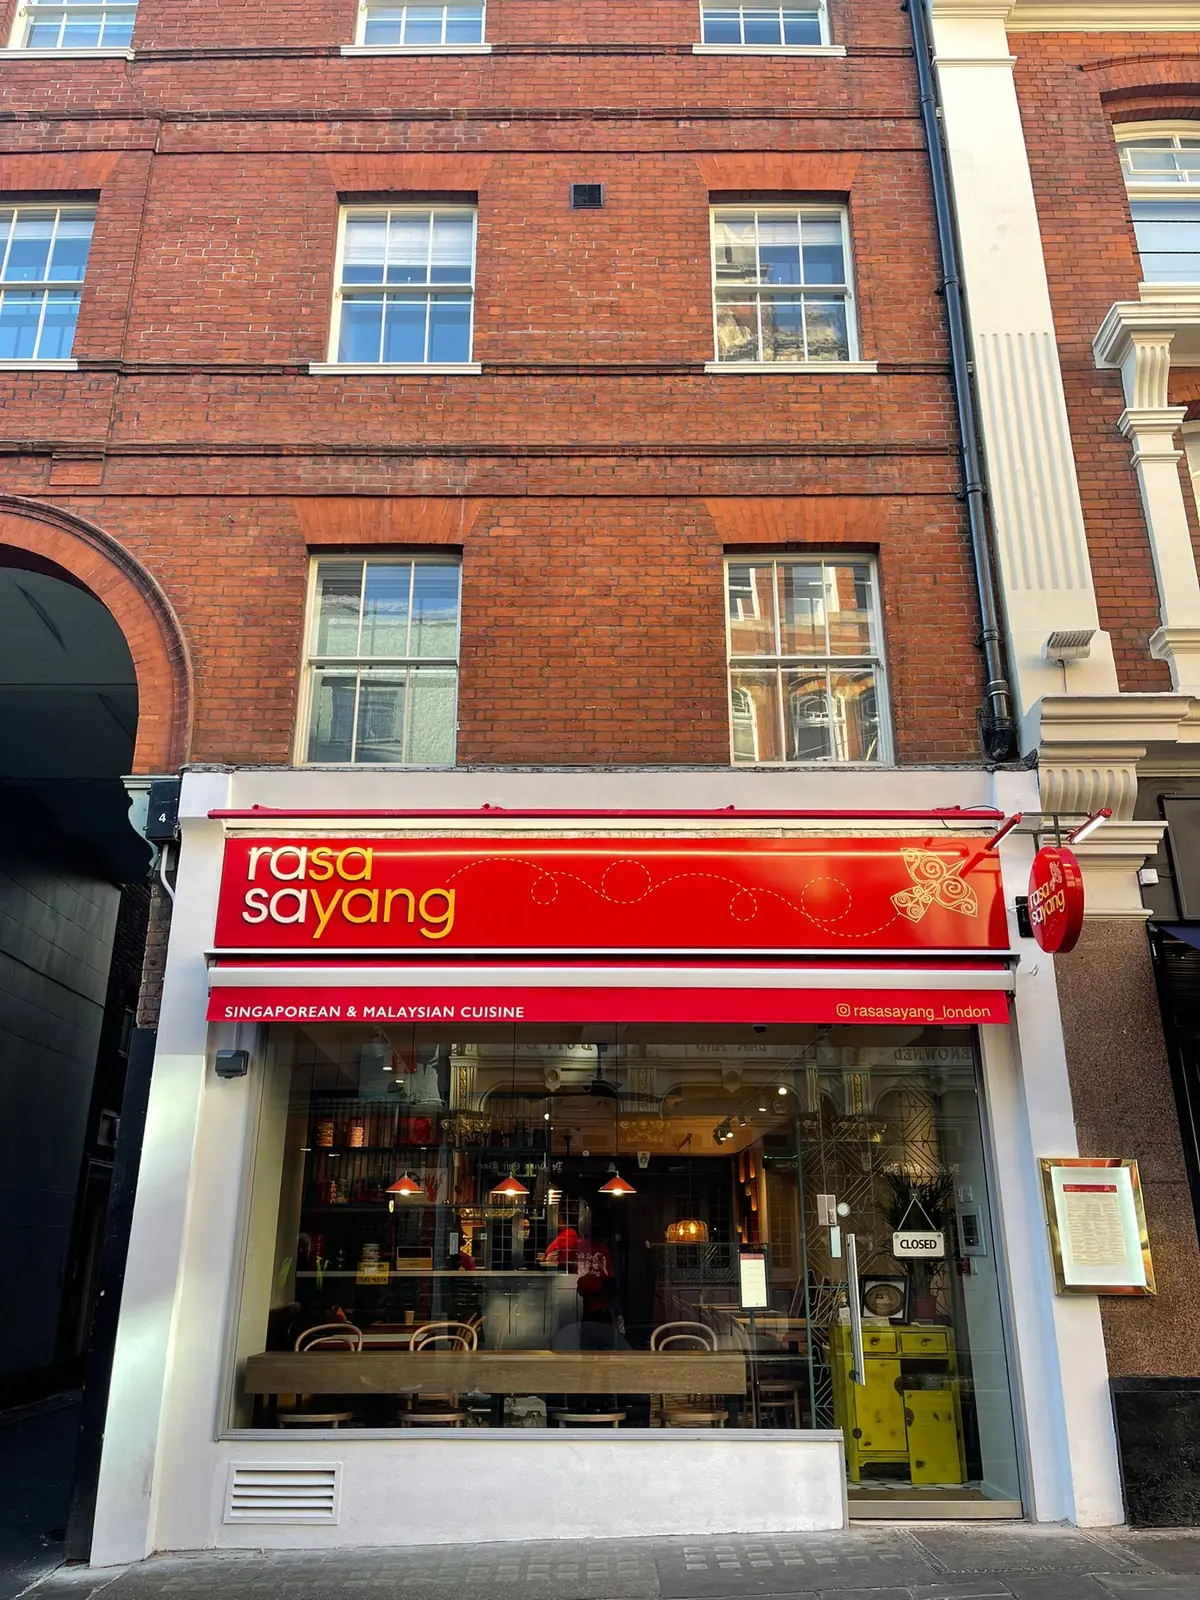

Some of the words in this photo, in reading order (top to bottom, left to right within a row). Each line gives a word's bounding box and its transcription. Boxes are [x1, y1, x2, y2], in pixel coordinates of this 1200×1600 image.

[158, 812, 166, 823] 4
[247, 845, 373, 881] rasa
[1030, 882, 1049, 909] rasa
[241, 888, 456, 939] sayang
[1032, 889, 1065, 926] sayang
[224, 1006, 341, 1018] SINGAPOREAN
[346, 1006, 357, 1017] &
[363, 1006, 455, 1018] MALAYSIAN
[460, 1006, 524, 1018] CUISINE
[853, 1005, 991, 1021] rasasayang_london
[900, 1239, 937, 1250] CLOSED
